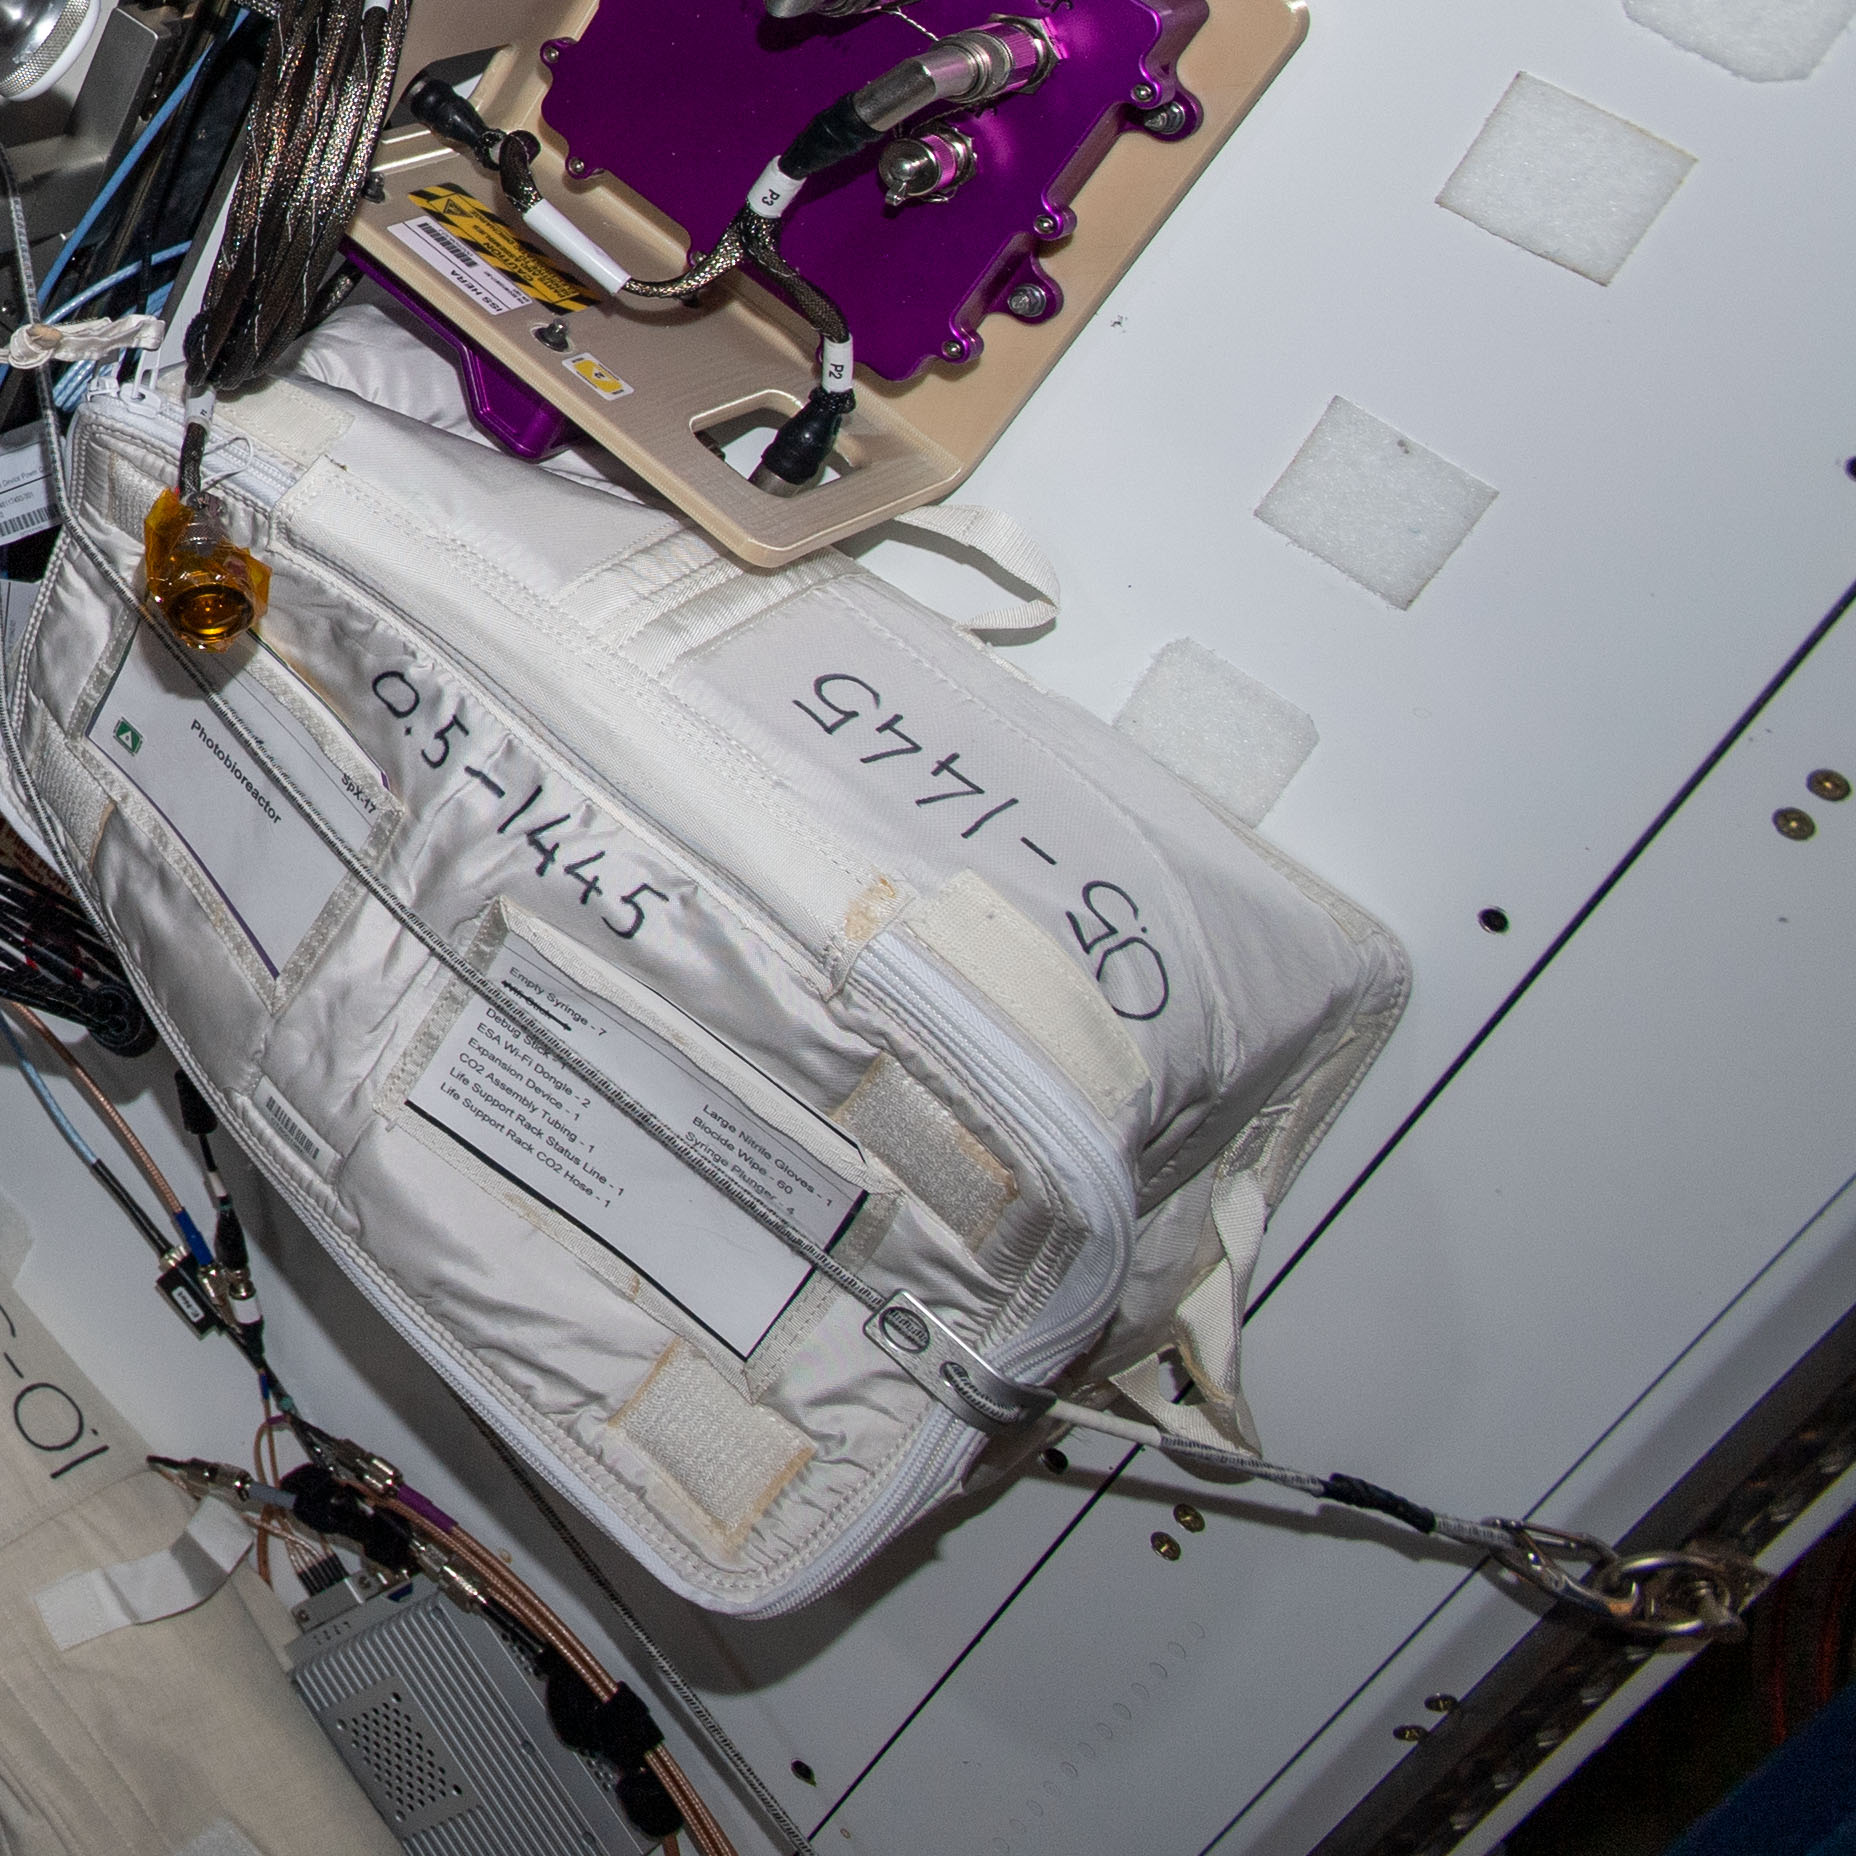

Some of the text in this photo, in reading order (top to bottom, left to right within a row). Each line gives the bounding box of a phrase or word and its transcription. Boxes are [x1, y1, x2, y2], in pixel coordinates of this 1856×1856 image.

[760, 186, 782, 208] P3
[451, 269, 484, 298] HERA
[485, 242, 535, 283] CAUTION
[482, 296, 502, 313] ISS
[827, 359, 845, 381] P2
[190, 718, 283, 825] Photobioreactor
[340, 772, 377, 815] SpX-17
[371, 669, 670, 941] 0.5-1445
[792, 673, 1169, 1021] 0.5-1445
[486, 1007, 526, 1040] Debug
[509, 966, 546, 998] Empty
[547, 987, 588, 1027] Syringe
[467, 1037, 522, 1082] Expansion
[523, 1070, 564, 1106] Device
[476, 1023, 503, 1045] ESA
[504, 1038, 534, 1064] Wi-Fi
[534, 1061, 572, 1096] Dongle
[449, 1067, 608, 1185] Life Support Rack Status Line
[459, 1052, 579, 1144] CO2 Assembly Tubing
[440, 1081, 595, 1198] Life Support Rack CO2 Hose
[685, 1131, 777, 1200] Syringe Plunger
[692, 1116, 794, 1195] Biocide Wipe 60
[702, 1104, 816, 1195] Large Nitrile Gloves
